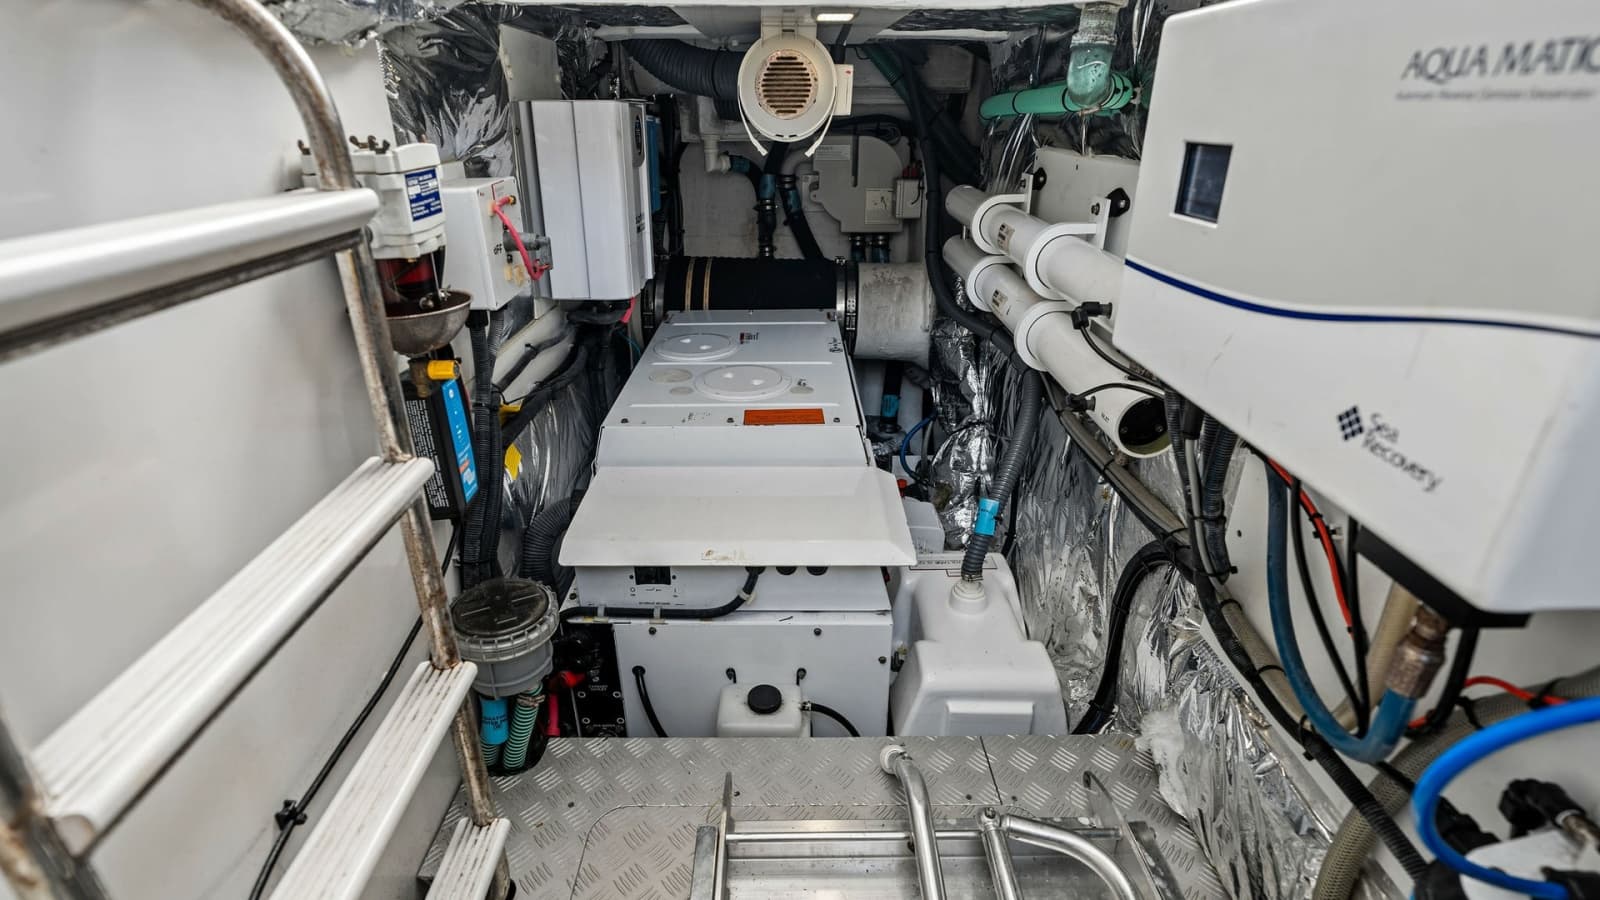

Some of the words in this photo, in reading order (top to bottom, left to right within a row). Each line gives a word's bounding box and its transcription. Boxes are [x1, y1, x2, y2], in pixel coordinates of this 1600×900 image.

[1401, 44, 1488, 84] AQUA
[1370, 412, 1399, 443] Sea
[1362, 430, 1444, 493] Recovery
